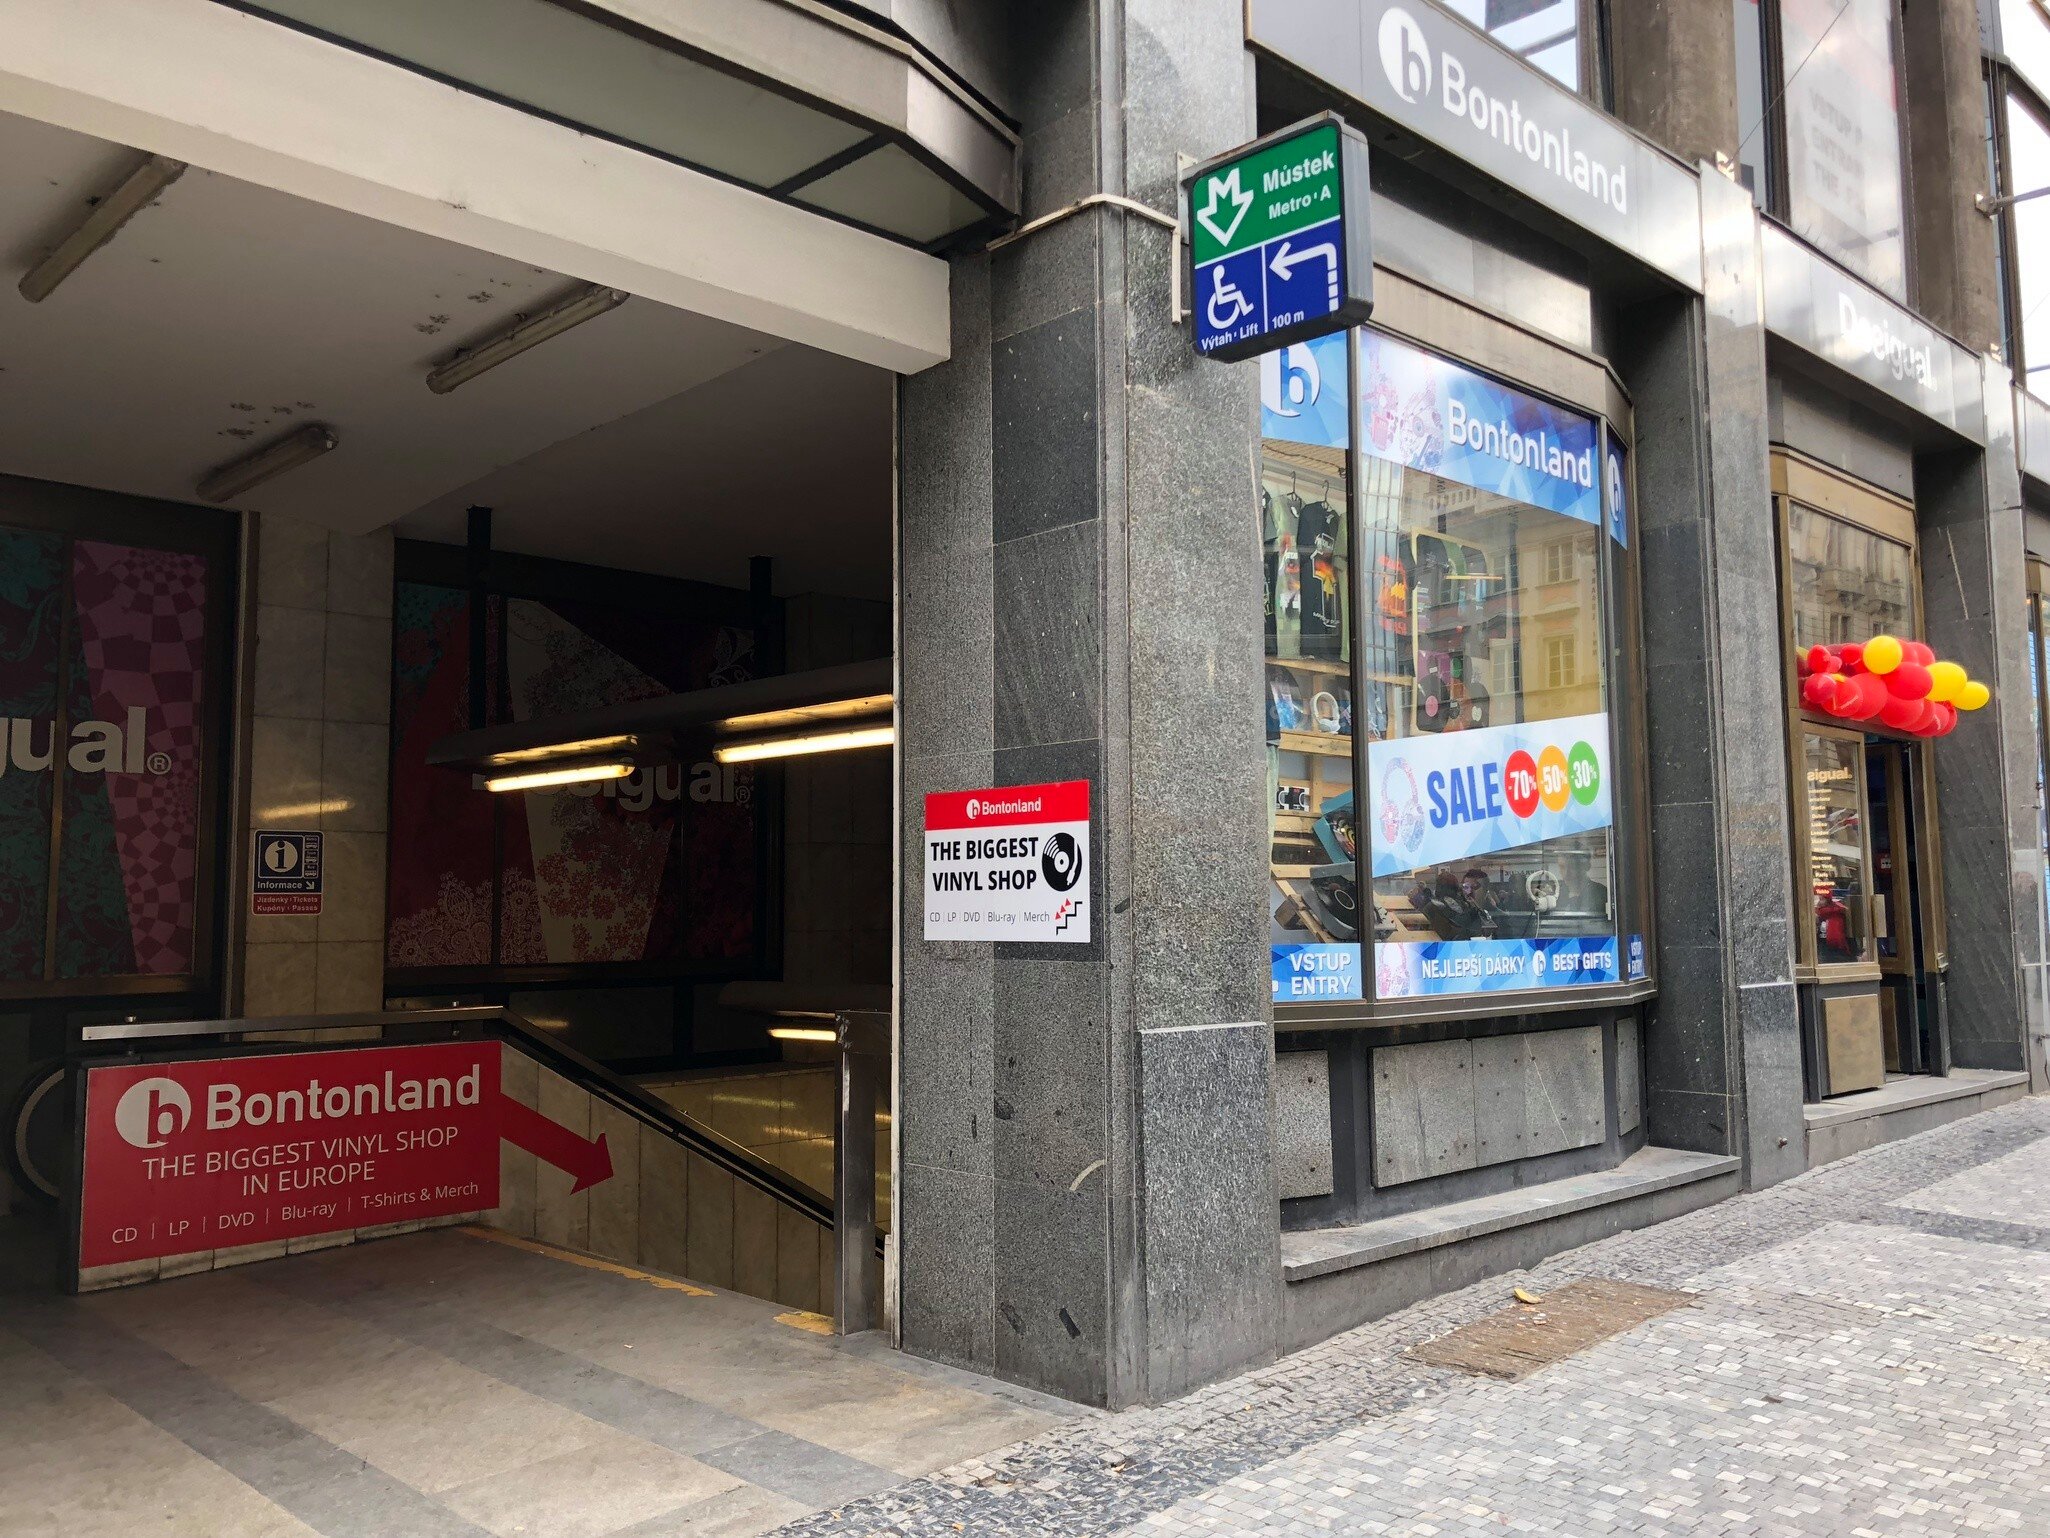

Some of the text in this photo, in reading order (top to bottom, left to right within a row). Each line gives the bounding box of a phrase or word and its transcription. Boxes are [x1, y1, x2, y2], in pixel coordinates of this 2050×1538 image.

[1441, 52, 1628, 215] Bontonland
[1269, 185, 1331, 220] Metro A
[1272, 311, 1304, 329] 100 m
[1201, 322, 1259, 351] Výtah Lift
[1448, 398, 1592, 488] Bontonland
[982, 797, 1042, 816] Bontonland
[1427, 759, 1598, 829] SALE -70% -50% -30%
[931, 837, 1039, 861] THE BIGGEST
[257, 881, 303, 889] Informace
[933, 870, 1037, 891] VINYL SHOP
[257, 904, 286, 912] Kupóny
[929, 910, 1050, 926] CD LP DVD Blu-ray Merch
[1290, 952, 1352, 971] VSTUP
[1421, 952, 1612, 979] NEJLEPŠÍ DÁRKY BEST GIFTS
[1291, 975, 1353, 995] ENTRY
[206, 1064, 480, 1130] Bontonland
[142, 1126, 459, 1180] THE BIGGEST VINYL SHOP
[243, 1160, 376, 1196] IN EUROPE
[112, 1182, 479, 1244] CD LP DVD Blu-ray T-Shirts & Merch
